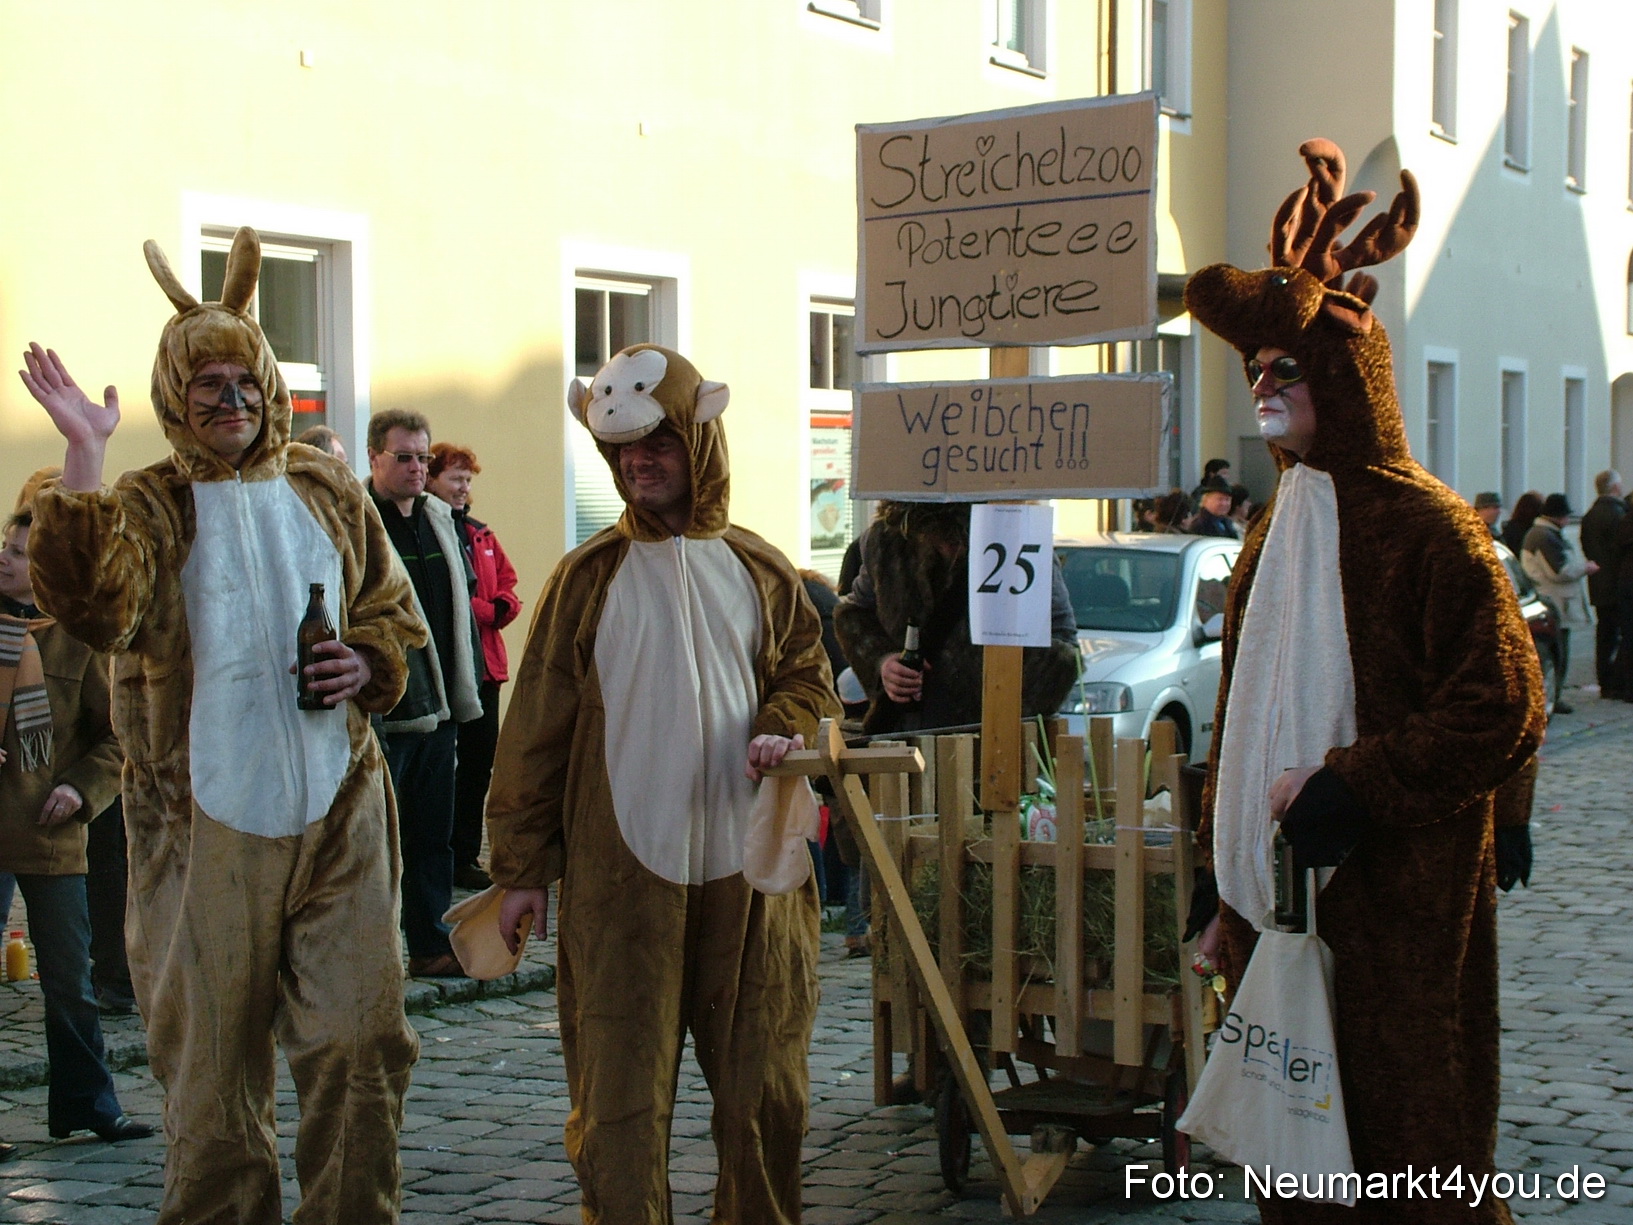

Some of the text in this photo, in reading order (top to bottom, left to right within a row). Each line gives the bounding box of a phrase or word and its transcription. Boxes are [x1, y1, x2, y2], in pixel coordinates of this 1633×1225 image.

[871, 126, 1142, 208] Streichelzoo
[897, 208, 1138, 268] Potenteee
[876, 273, 1100, 339] Jungtiere
[897, 384, 1090, 437] Weibchen
[976, 542, 1042, 596] 25
